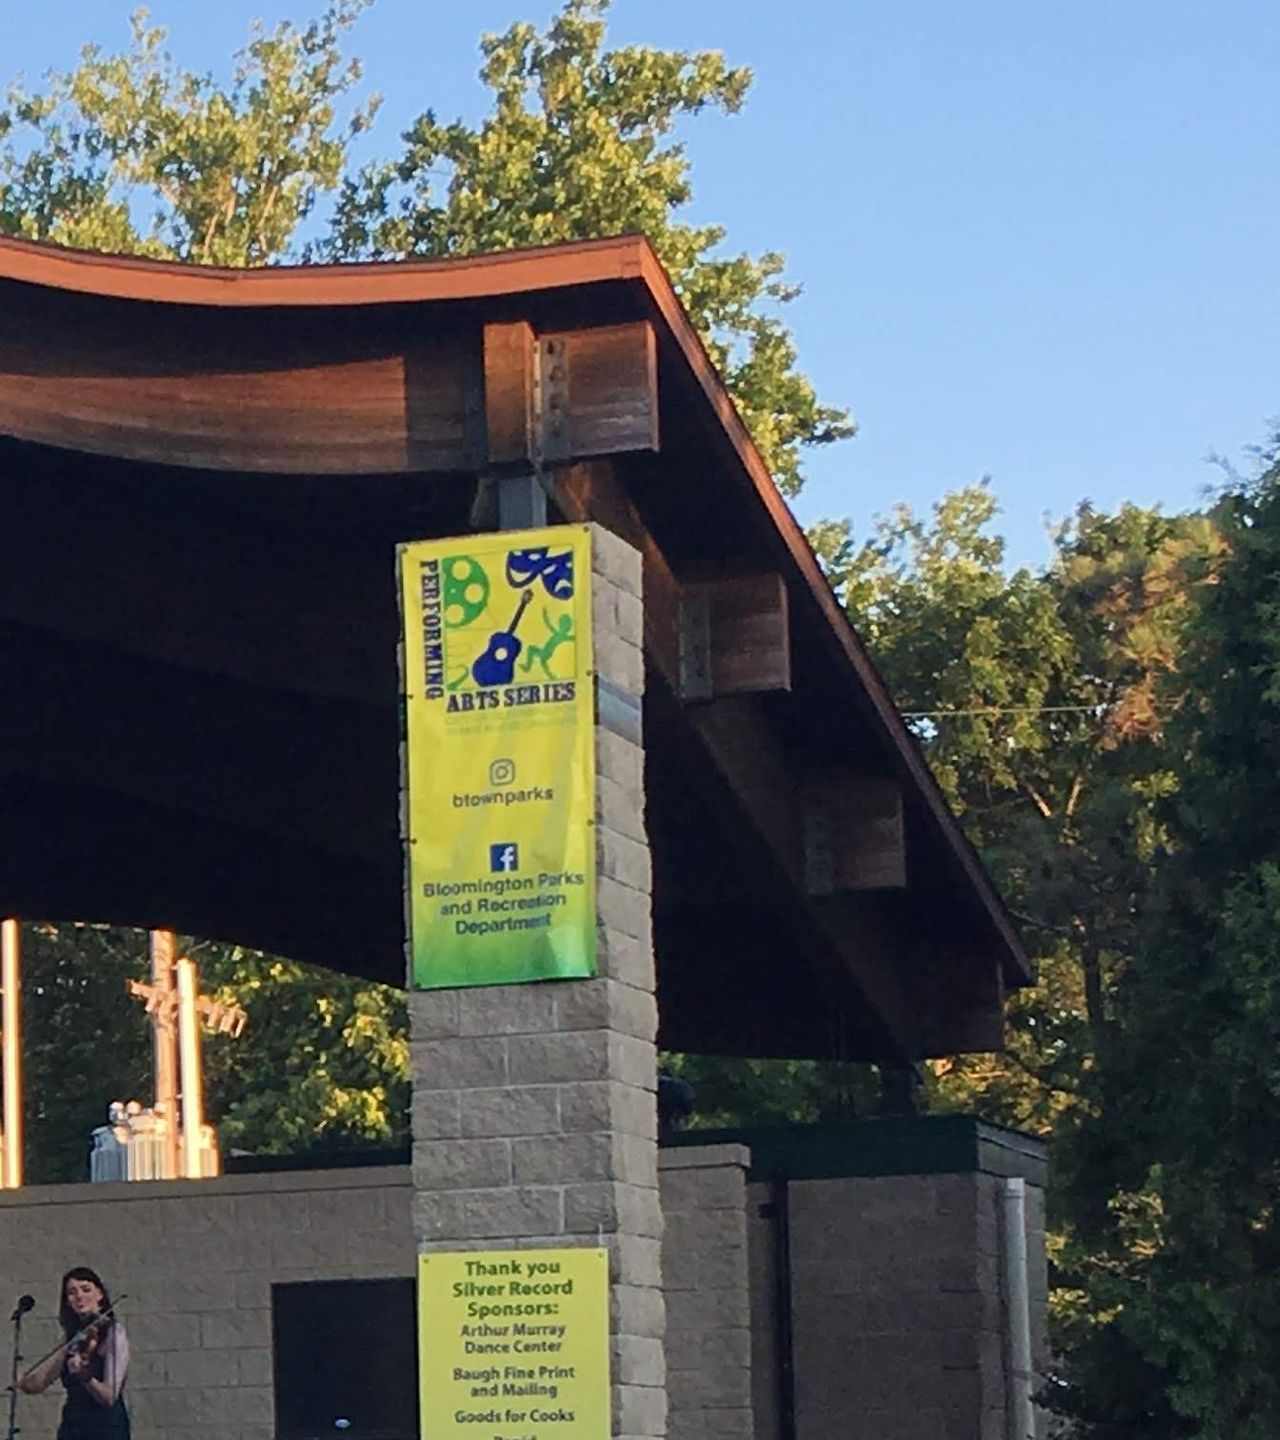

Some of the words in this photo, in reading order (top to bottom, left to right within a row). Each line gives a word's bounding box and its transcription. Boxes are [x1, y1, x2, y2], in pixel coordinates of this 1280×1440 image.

[420, 559, 444, 700] PERFORMING
[447, 690, 499, 713] ARTS
[504, 682, 576, 707] SERIES
[452, 787, 554, 808] btownparks
[423, 878, 533, 898] Bloomington
[538, 872, 585, 887] Parks
[441, 901, 472, 916] and
[478, 894, 566, 912] Recreation
[455, 912, 551, 935] Department
[464, 1260, 523, 1276] Thank
[527, 1262, 561, 1277] you
[453, 1281, 505, 1298] Silver
[509, 1279, 573, 1296] Record
[468, 1301, 559, 1319] Sponsors:
[460, 1324, 509, 1337] Arthur
[513, 1324, 566, 1338] Murray
[465, 1341, 510, 1354] Dance
[514, 1340, 562, 1353] Center
[453, 1367, 500, 1383] Baugh
[504, 1367, 535, 1379] Fine
[539, 1366, 576, 1379] Print
[471, 1384, 498, 1397] and
[502, 1383, 558, 1399] Mailing
[455, 1409, 502, 1424] Goods
[505, 1409, 526, 1422] for
[530, 1408, 575, 1422] Cooks
